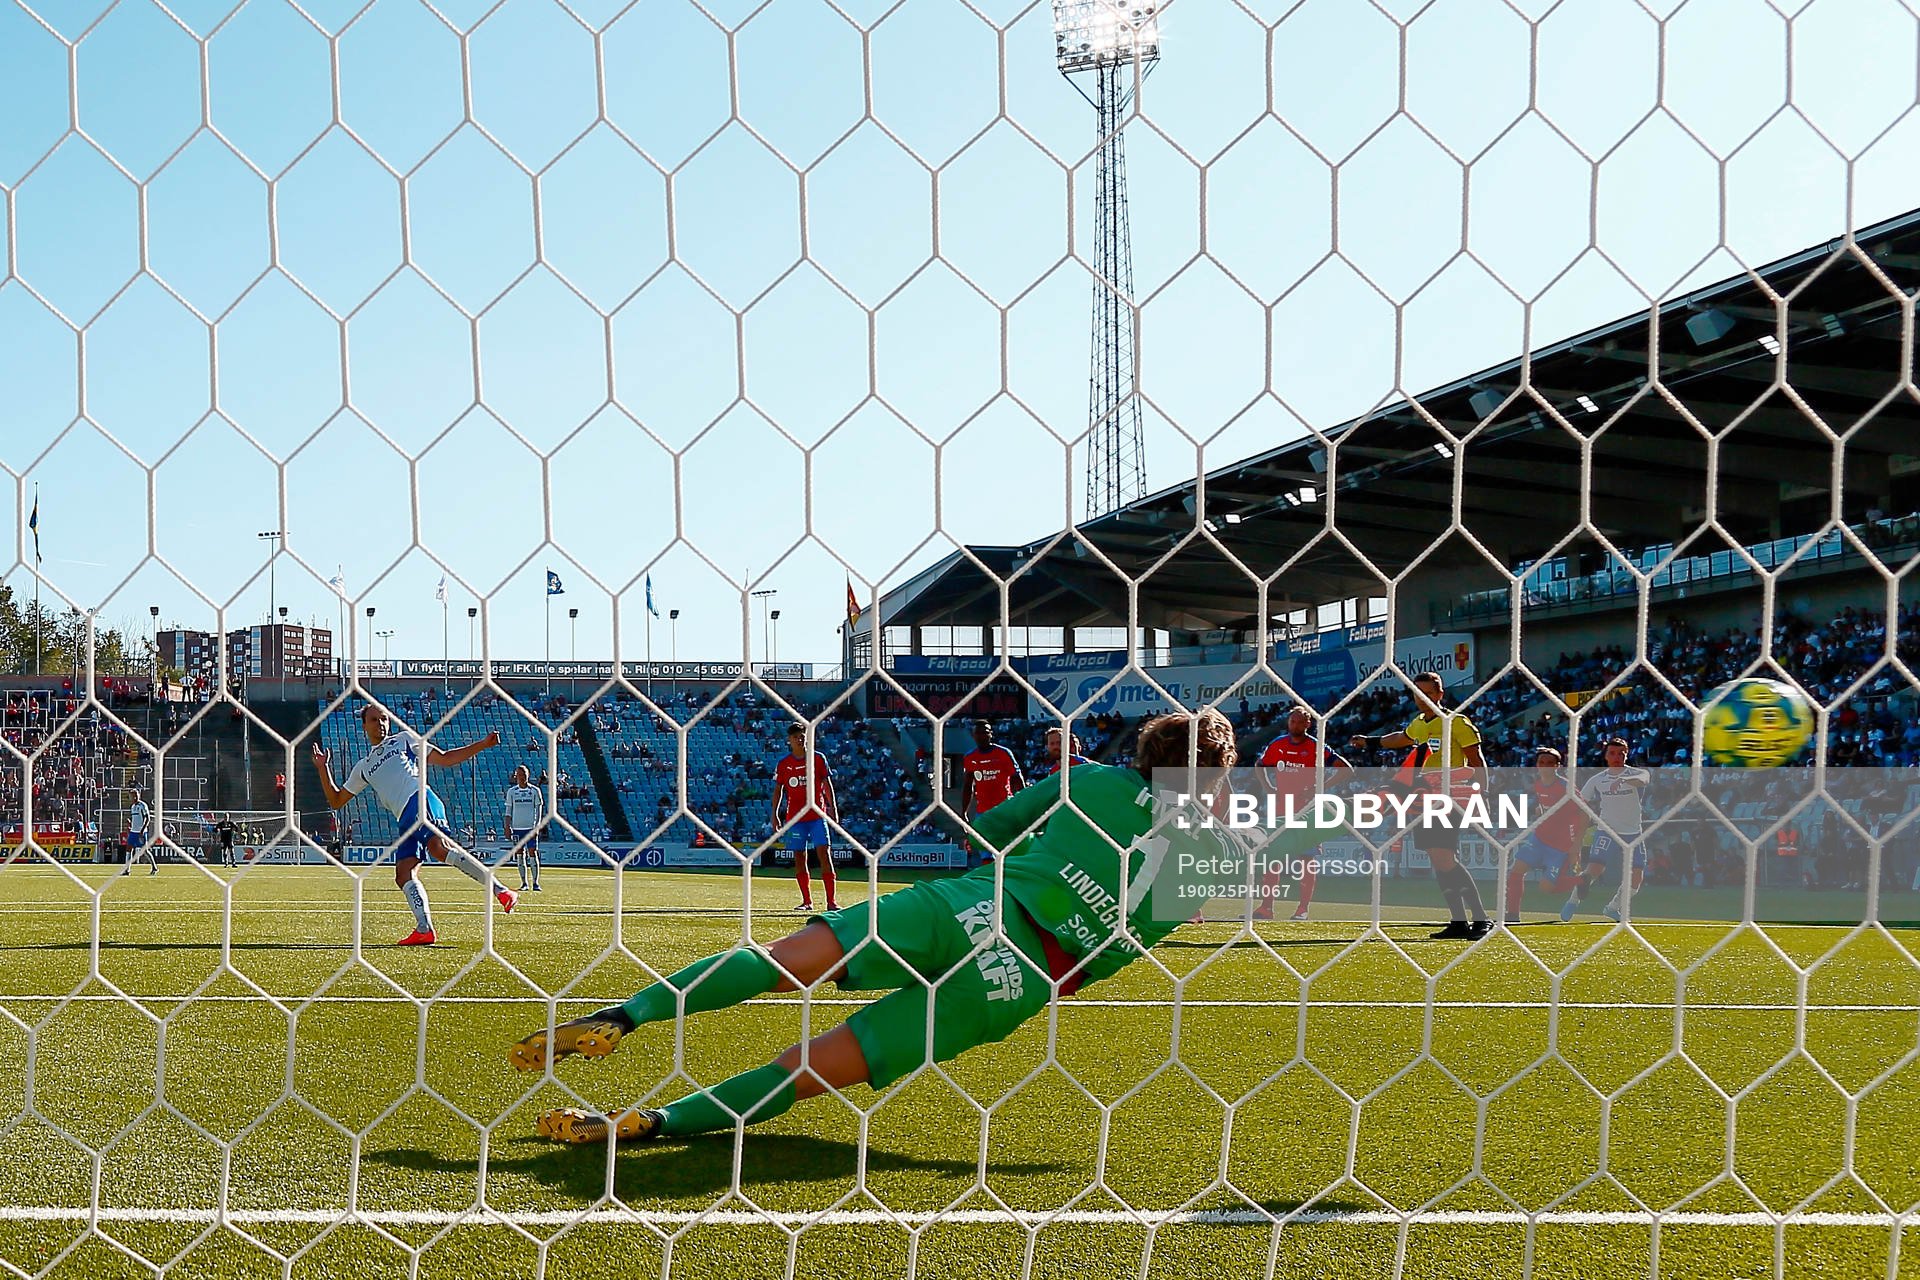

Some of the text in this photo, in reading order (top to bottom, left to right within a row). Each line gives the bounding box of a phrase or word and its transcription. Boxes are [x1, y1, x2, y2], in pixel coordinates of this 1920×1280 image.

[928, 657, 993, 671] Folkpool
[1047, 652, 1112, 669] Folkpool
[1359, 658, 1406, 682] Svensa
[1408, 650, 1452, 675] kyrkan
[406, 662, 419, 674] Vi
[479, 663, 510, 677] dgar
[513, 664, 532, 674] IFK
[558, 664, 593, 677] spelar
[594, 664, 633, 675] math.
[635, 664, 660, 677] Ring
[662, 665, 683, 675] 010
[693, 665, 708, 675] 45
[710, 665, 724, 675] 65
[874, 680, 951, 693] Tvilngarnas
[368, 748, 399, 777] HOLMEN
[0, 845, 91, 858] BÅKÄDER
[135, 846, 205, 857] OTIMRA
[274, 848, 306, 859] Smith
[564, 852, 597, 860] SEFAB
[775, 850, 795, 858] PEM
[833, 849, 852, 858] EMA
[886, 851, 945, 865] AsklingBil
[1059, 862, 1144, 953] LINDEG
[975, 899, 1024, 1000] ÖUNDS
